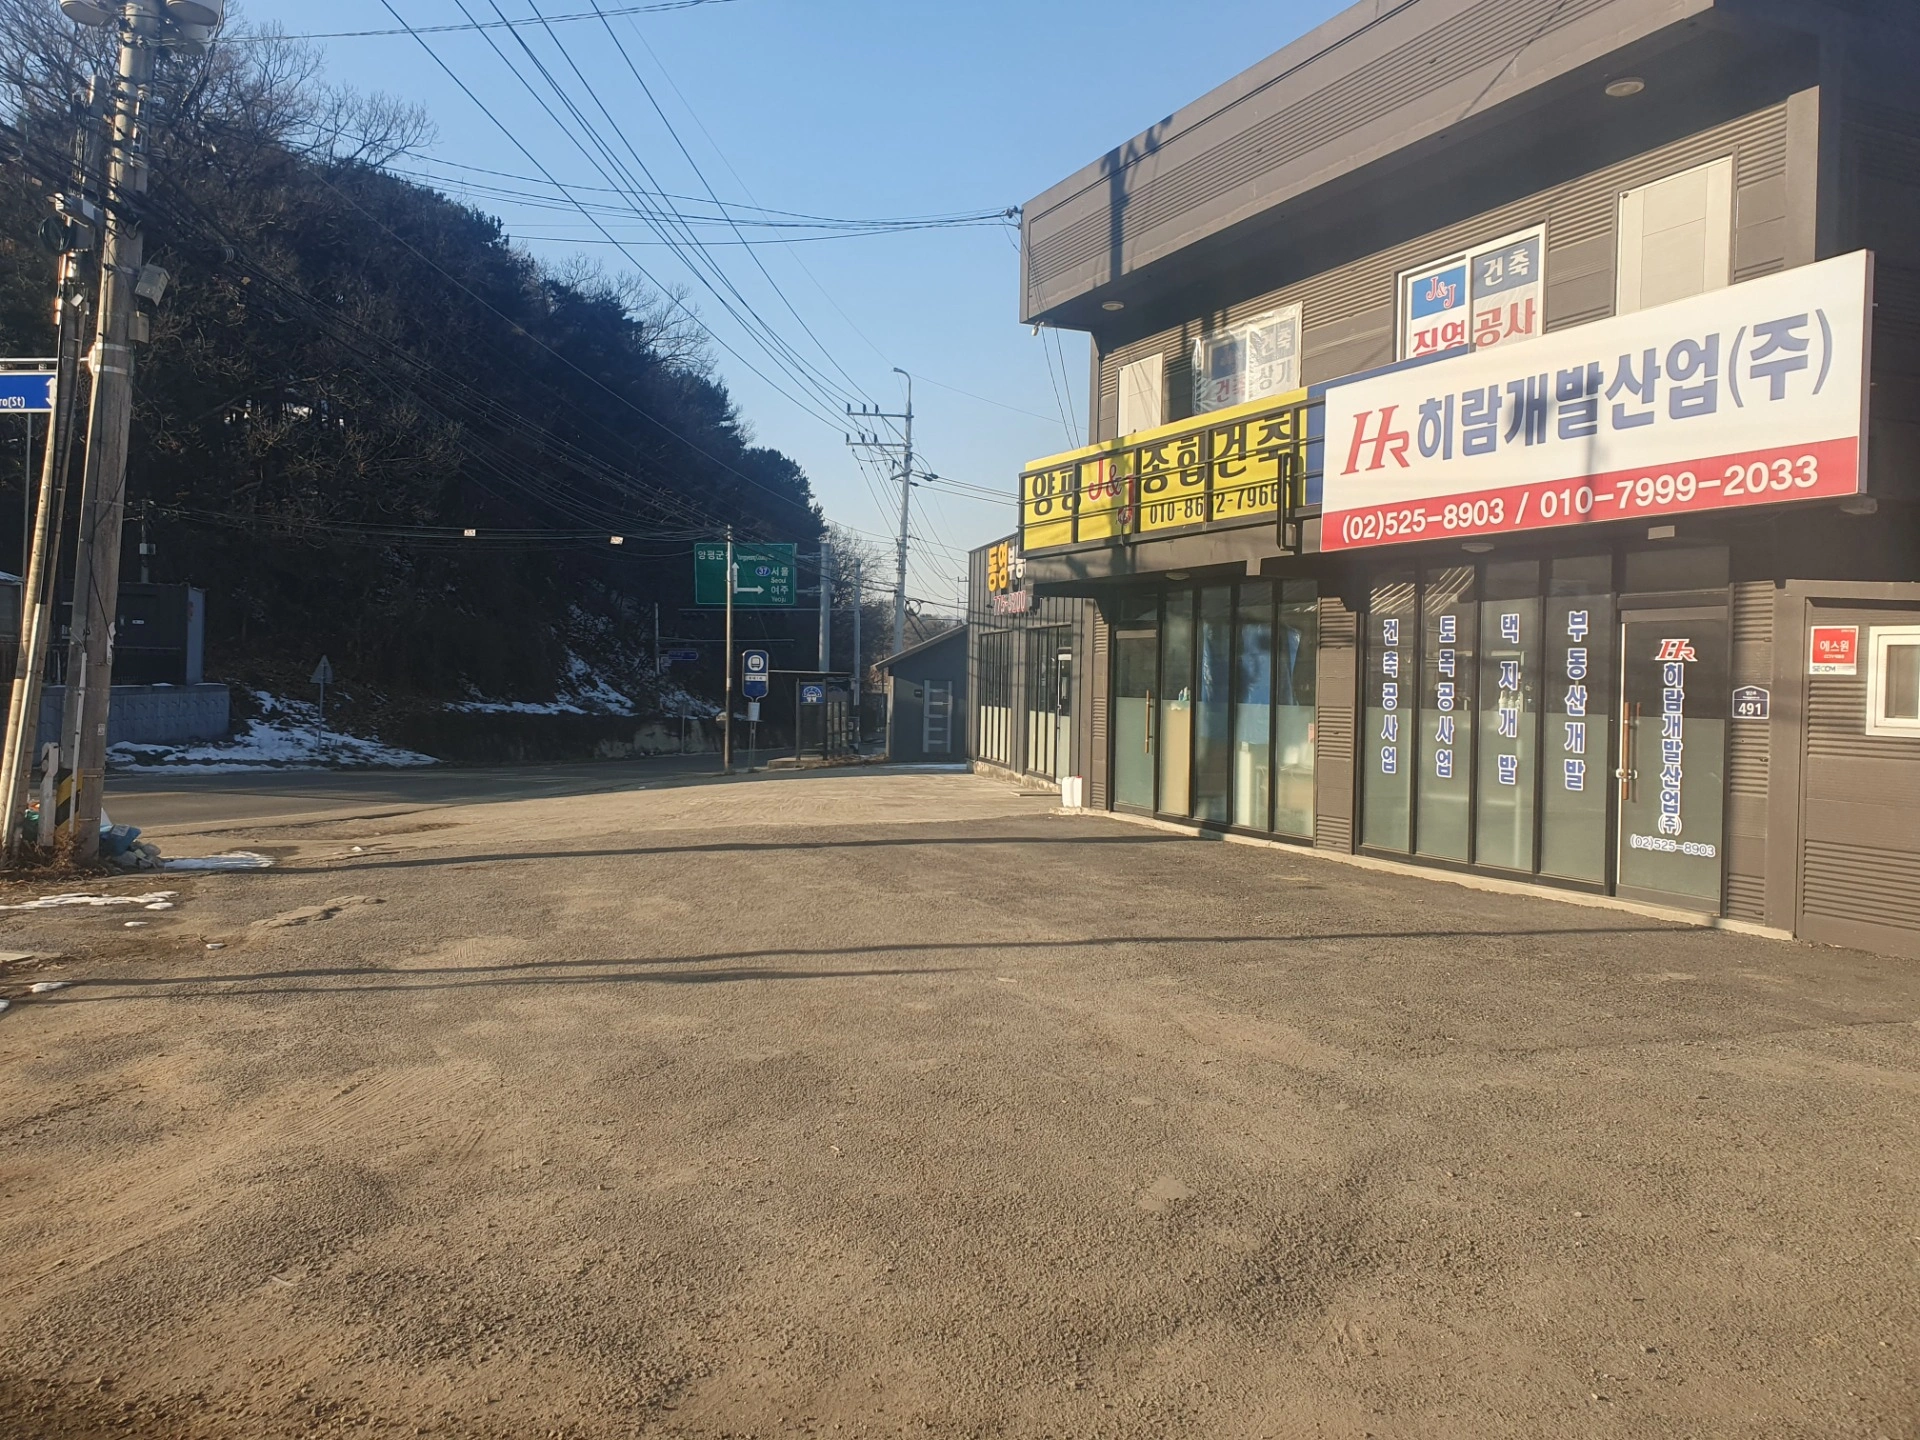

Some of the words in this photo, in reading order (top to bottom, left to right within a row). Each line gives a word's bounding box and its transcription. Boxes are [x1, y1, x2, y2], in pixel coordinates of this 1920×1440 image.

[1483, 248, 1530, 286] 건축
[1426, 276, 1456, 309] J&J
[1413, 320, 1465, 357] 직영
[1474, 298, 1536, 347] 공사
[1340, 405, 1411, 476] HR
[1417, 309, 1833, 460] 히람개발산업(주)
[1150, 481, 1280, 524] 010-862-7966
[1342, 497, 1505, 543] (02)525-8903
[1540, 455, 1819, 519] 010-7999-2033
[697, 550, 729, 560] 양평군
[758, 567, 768, 576] 37
[771, 567, 789, 577] 서울
[771, 586, 789, 595] 여주
[1655, 639, 1698, 661] HR
[1819, 640, 1849, 652] 에스원
[1380, 618, 1399, 774] 건축공사업
[1435, 615, 1457, 778] 토목공사업
[1498, 613, 1520, 785] 택지개발
[1564, 610, 1589, 791] 부동산개발
[1738, 702, 1762, 715] 491
[1630, 834, 1716, 857] (02)525-8903
